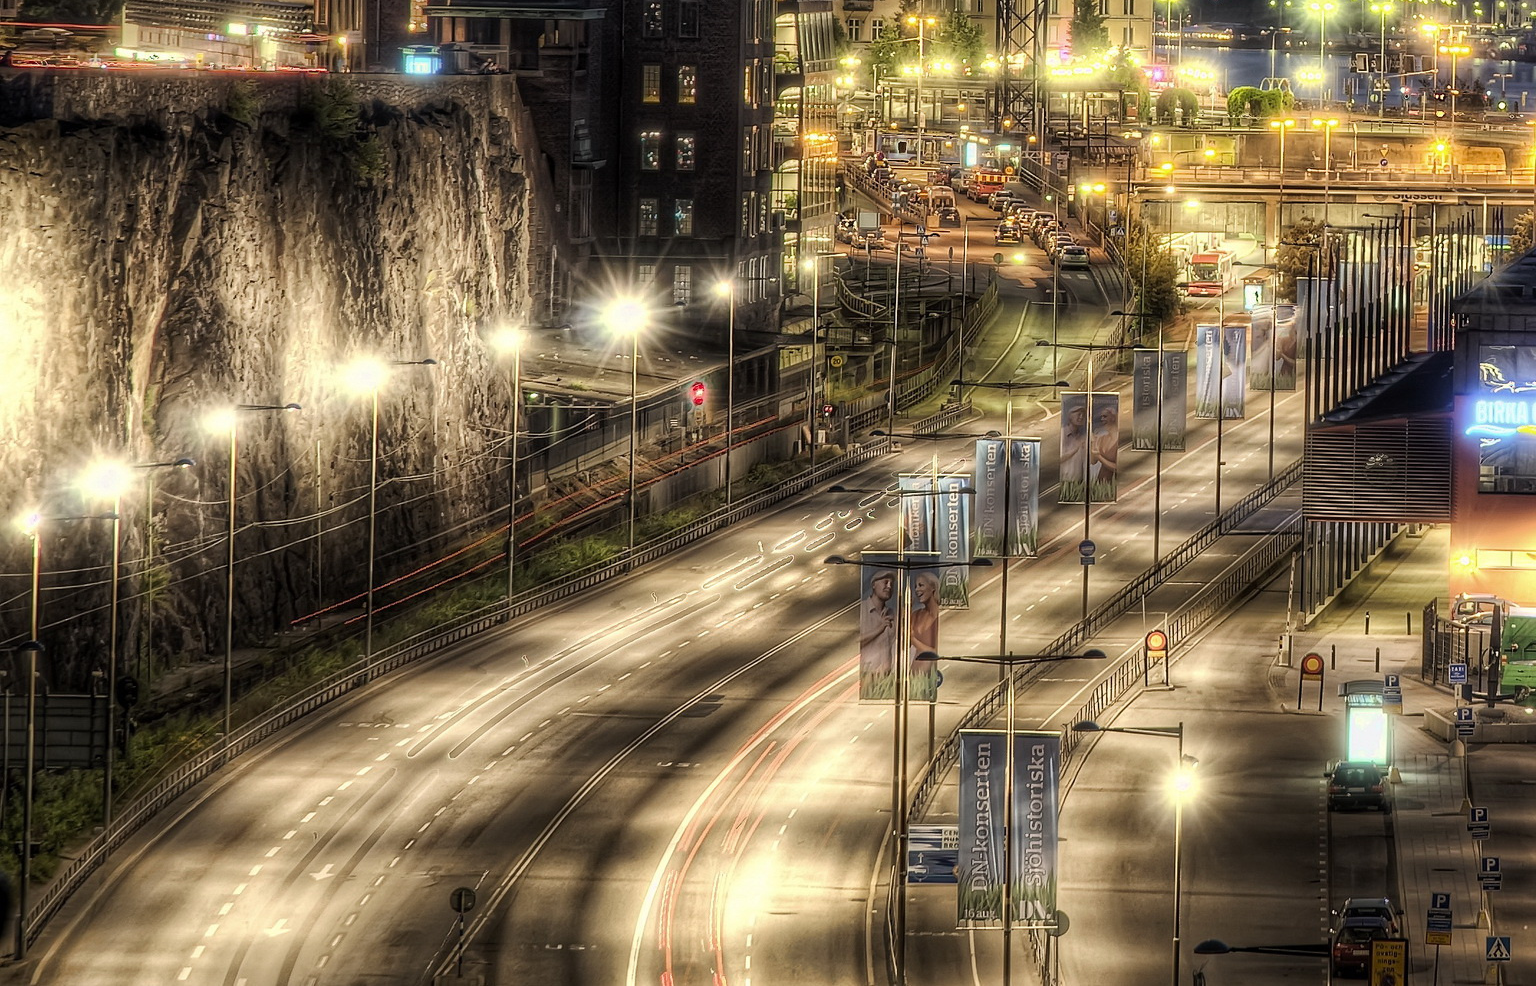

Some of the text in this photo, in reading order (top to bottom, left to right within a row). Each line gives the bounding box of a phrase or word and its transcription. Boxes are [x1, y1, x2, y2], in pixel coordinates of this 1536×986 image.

[1476, 400, 1528, 424] BIRKA
[971, 742, 992, 892] DN-konserten
[1025, 743, 1046, 887] Sjöhistoriska
